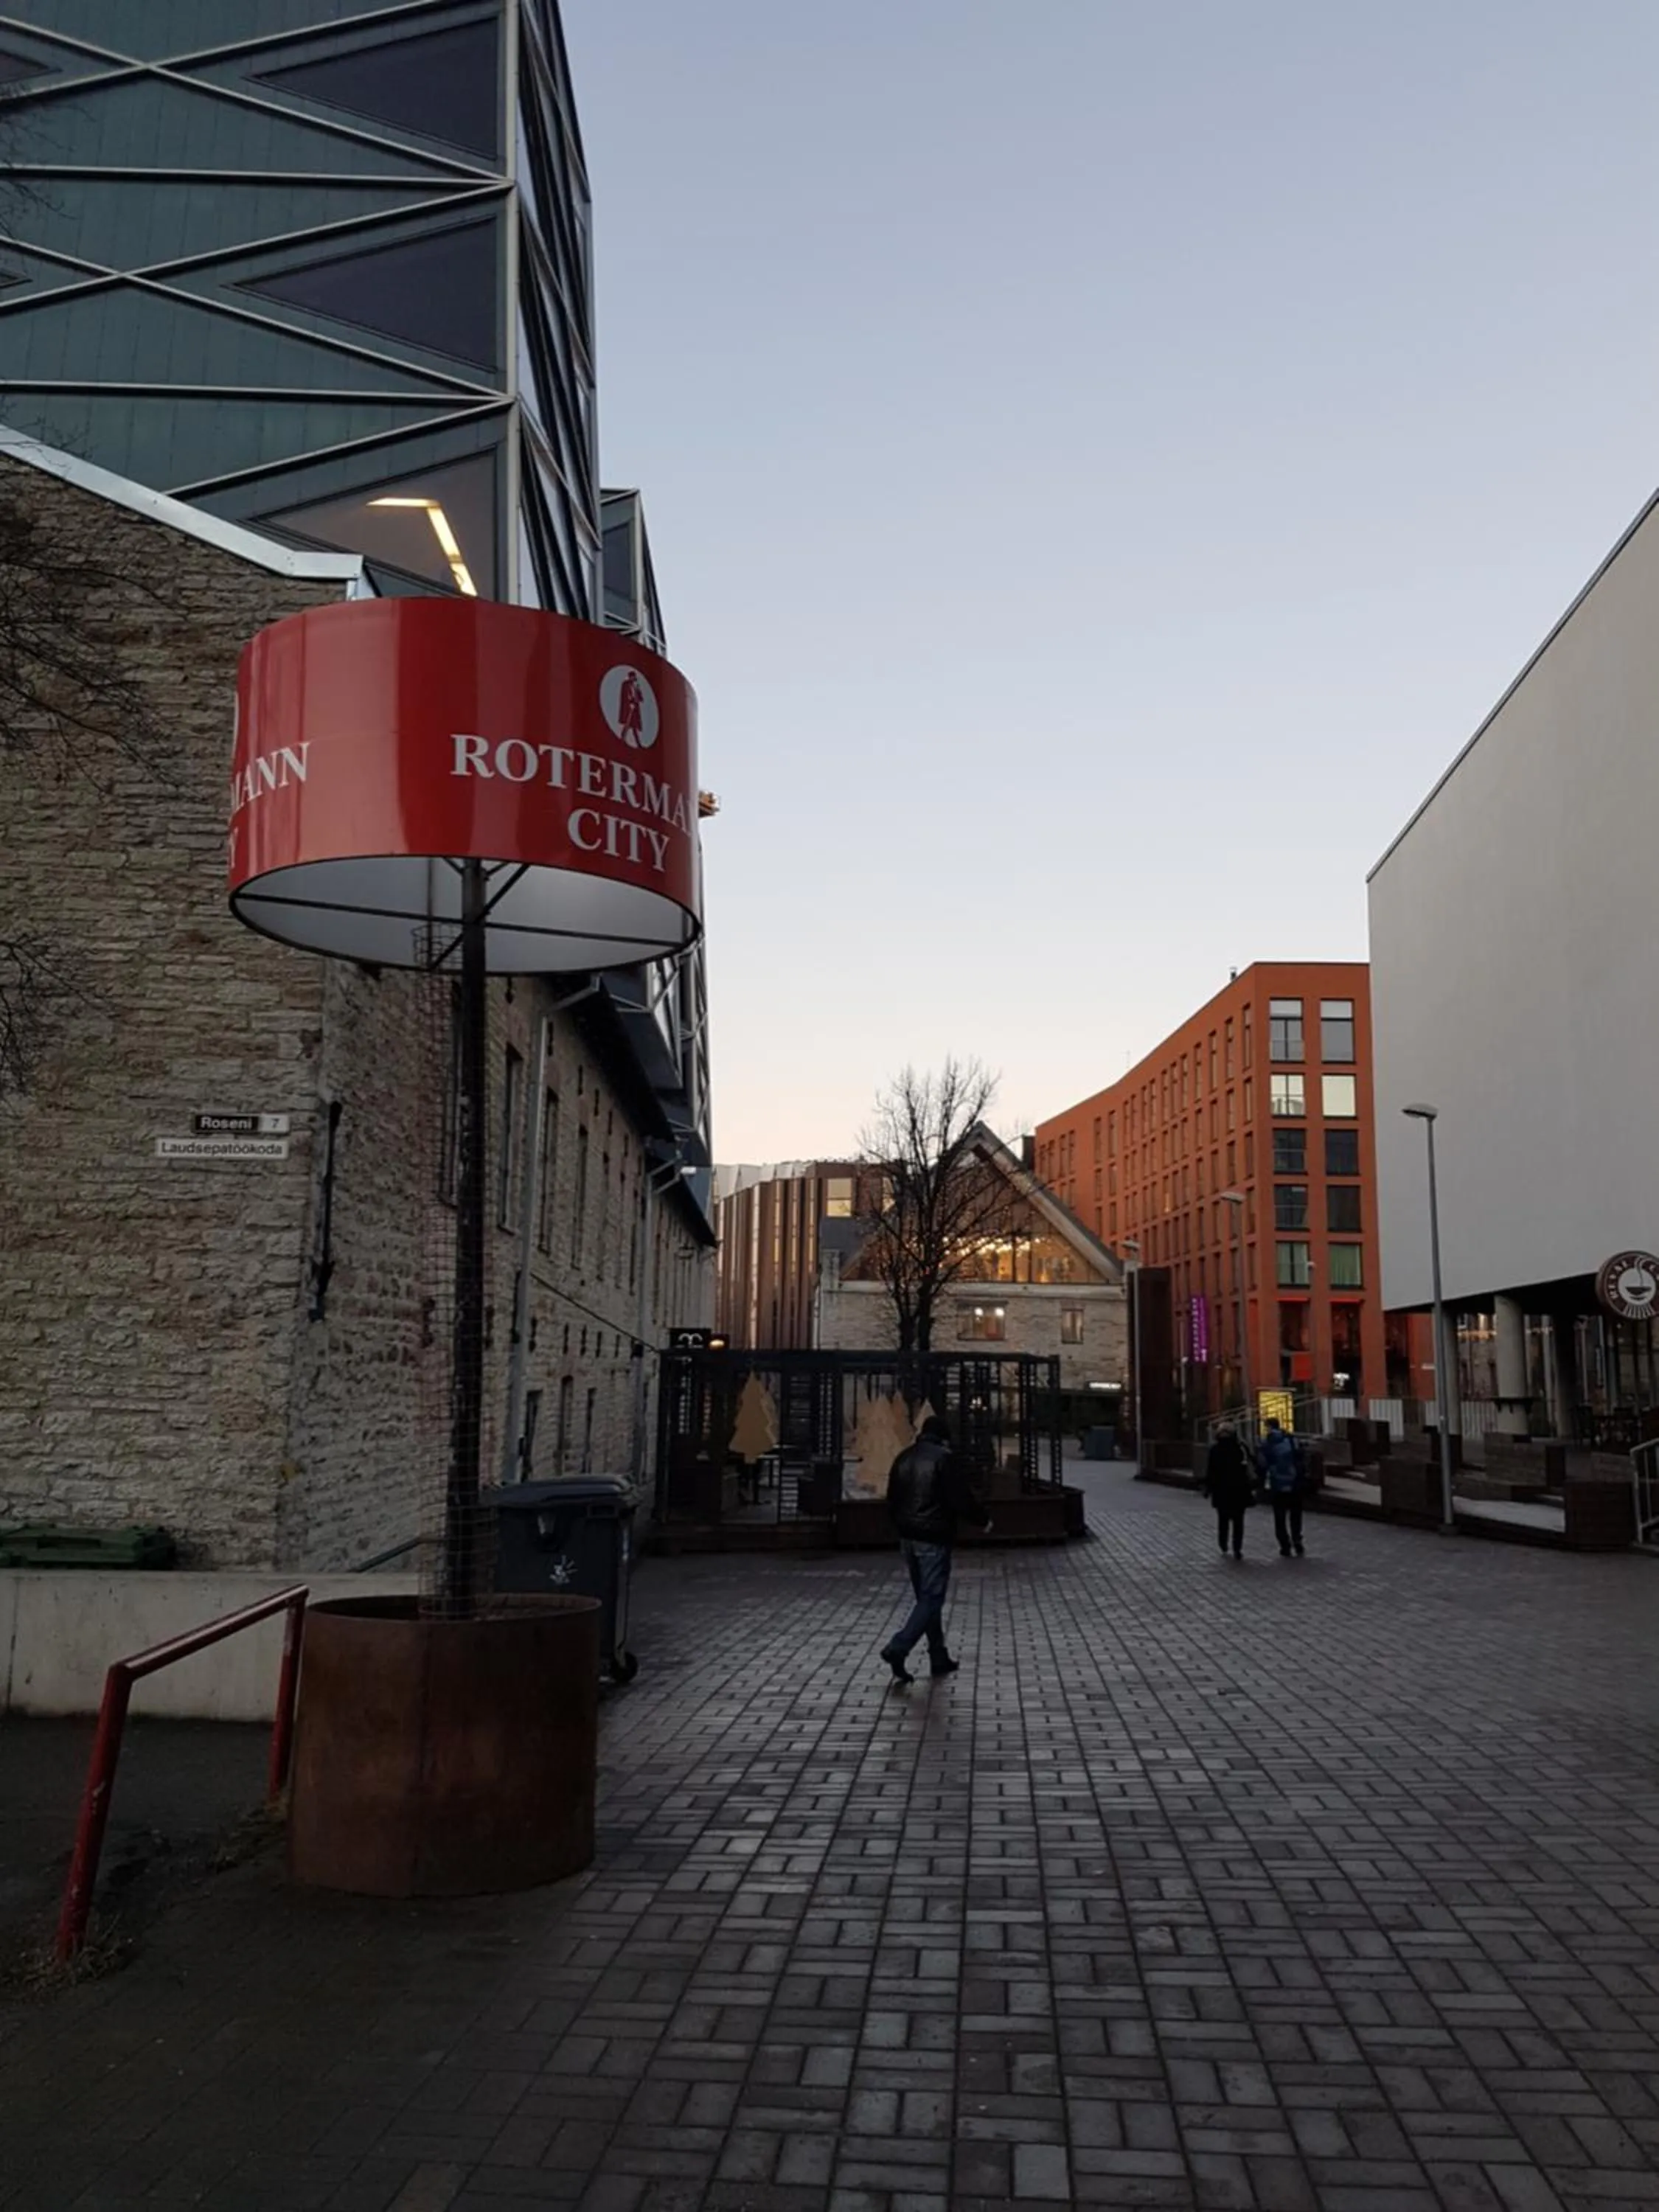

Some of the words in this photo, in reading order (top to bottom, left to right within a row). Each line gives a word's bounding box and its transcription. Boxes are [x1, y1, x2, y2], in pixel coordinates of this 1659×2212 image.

[568, 808, 670, 873] CITY
[199, 1116, 252, 1130] Roseni
[271, 1119, 279, 1129] 7
